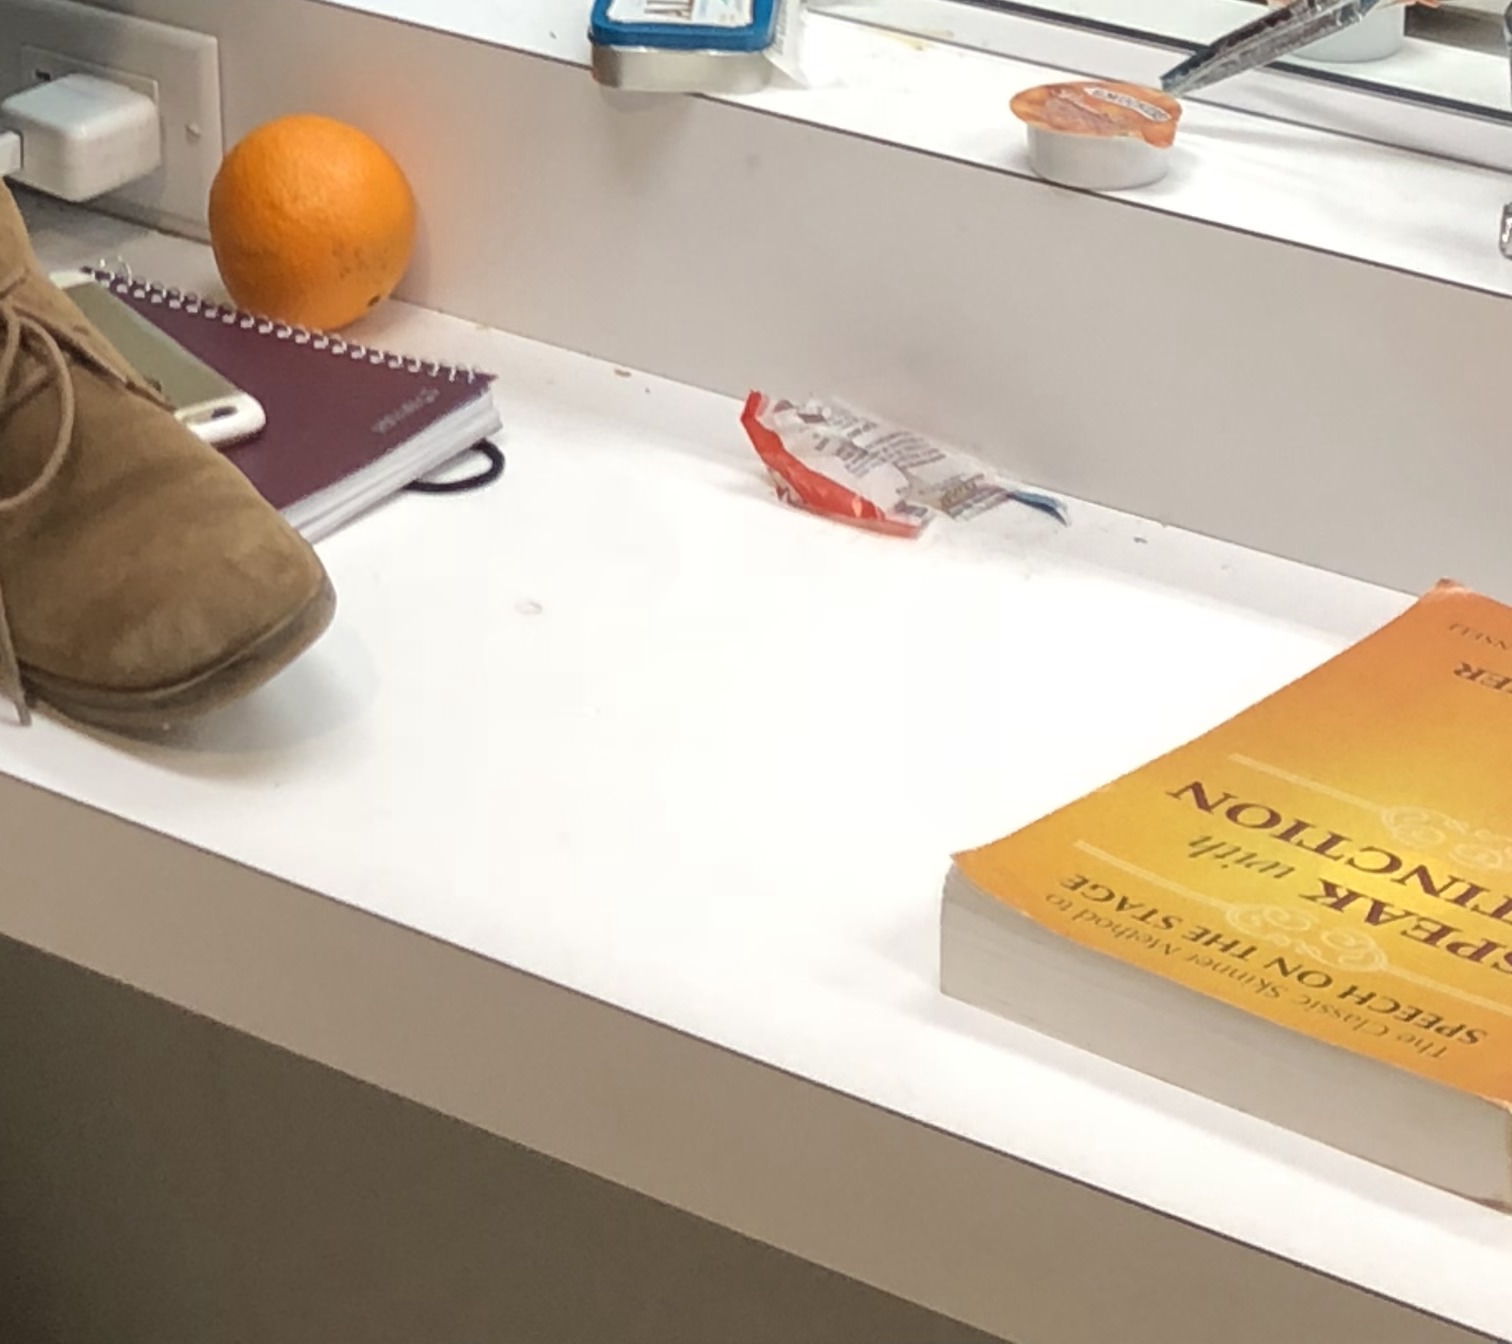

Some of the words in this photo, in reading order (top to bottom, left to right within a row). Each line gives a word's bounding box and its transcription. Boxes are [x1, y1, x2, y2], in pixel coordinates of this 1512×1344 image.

[1188, 834, 1295, 880] with
[1045, 893, 1074, 912] to
[1059, 874, 1183, 931] STAGE
[1072, 909, 1181, 956] Method
[1181, 925, 1258, 962] THE
[1186, 954, 1288, 999] Skinner
[1263, 957, 1333, 989] ON
[1291, 994, 1390, 1037] Classic
[1336, 985, 1488, 1045] SPEECH
[1395, 1032, 1448, 1059] The
